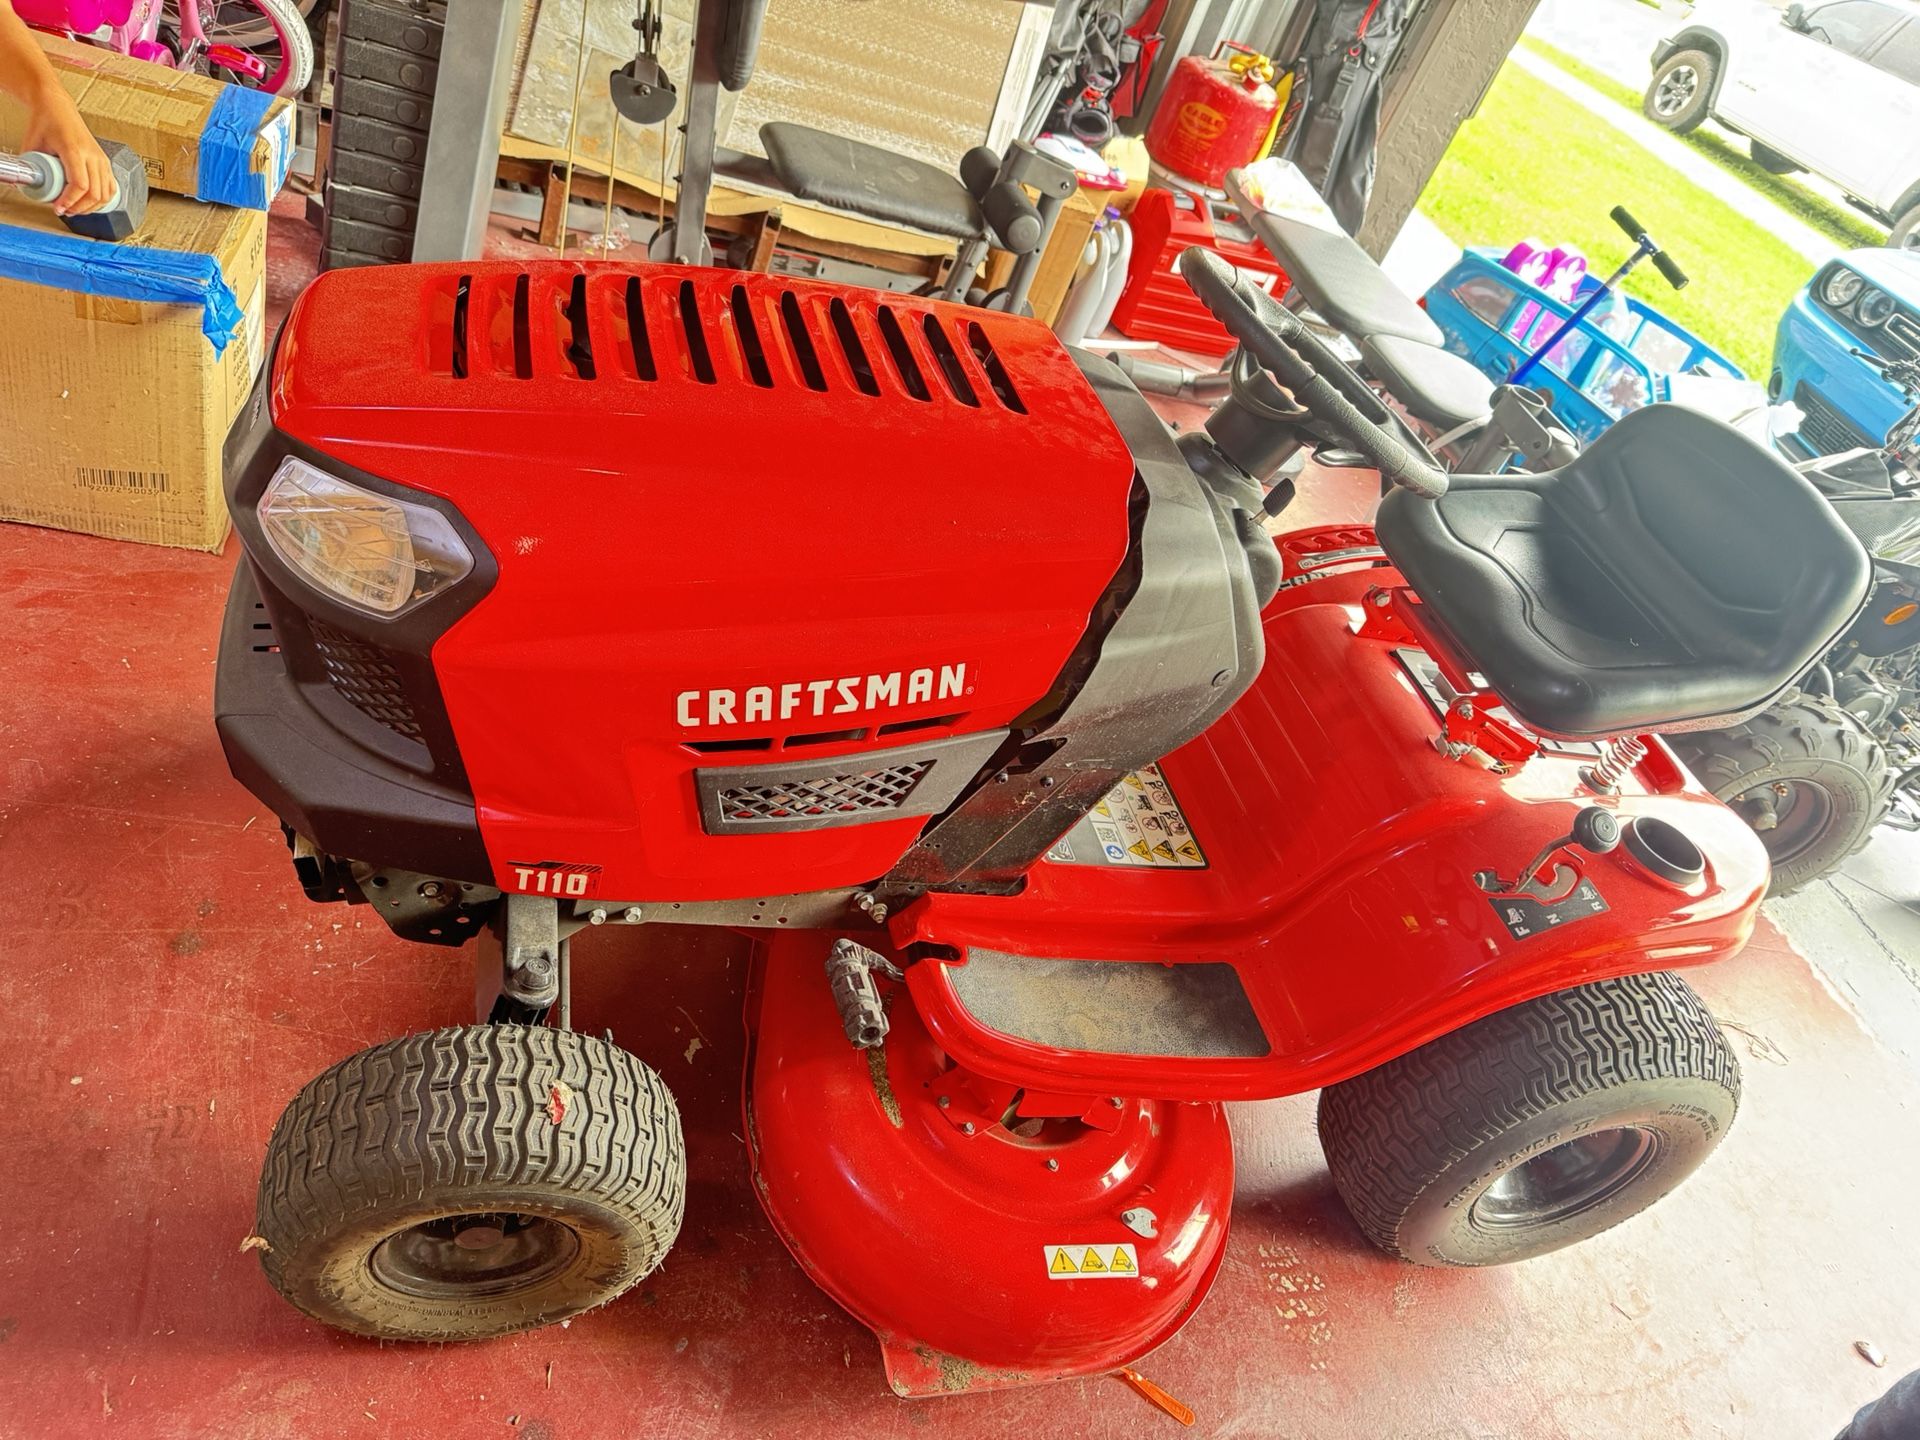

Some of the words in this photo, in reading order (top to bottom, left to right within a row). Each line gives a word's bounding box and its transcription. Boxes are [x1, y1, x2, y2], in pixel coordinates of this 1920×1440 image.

[677, 662, 966, 727] CRAFTSMAN
[515, 868, 588, 895] T110
[514, 926, 530, 937] F
[546, 913, 561, 925] N
[590, 901, 603, 911] R
